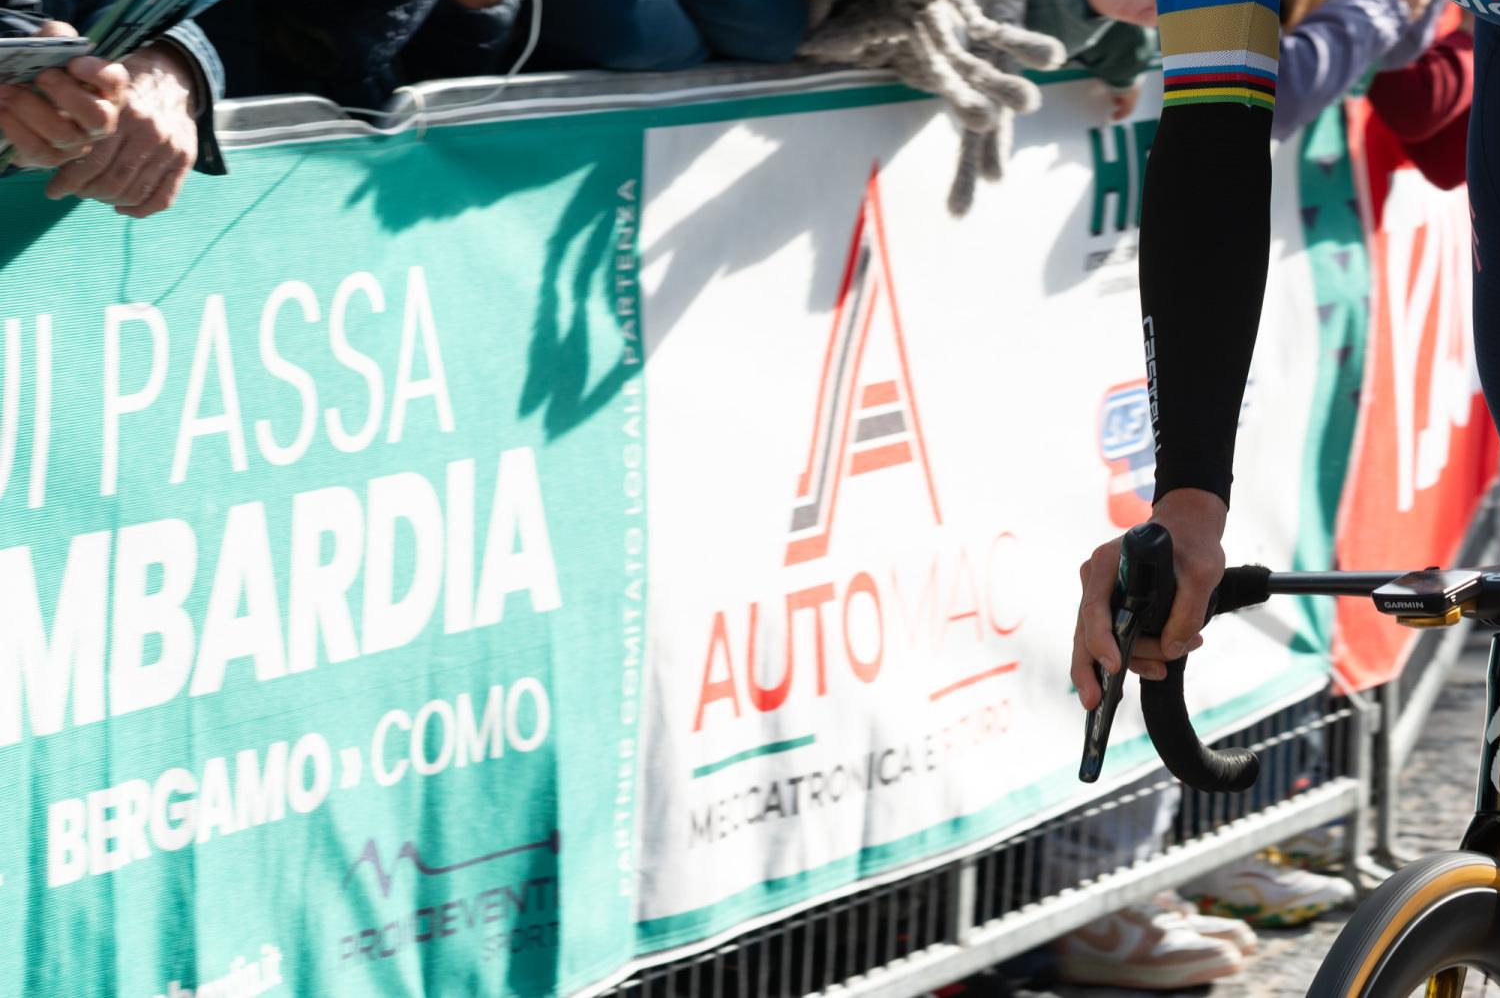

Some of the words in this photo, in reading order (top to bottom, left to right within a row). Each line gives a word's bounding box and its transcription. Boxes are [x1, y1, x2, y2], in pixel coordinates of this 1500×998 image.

[615, 178, 642, 364] PARTENZA
[101, 265, 455, 496] PASSA
[619, 527, 643, 725] COMITATO
[1384, 601, 1425, 610] GARMIN
[47, 732, 331, 888] BERGAMO
[371, 677, 550, 787] COMO
[616, 738, 634, 897] PARTNER
